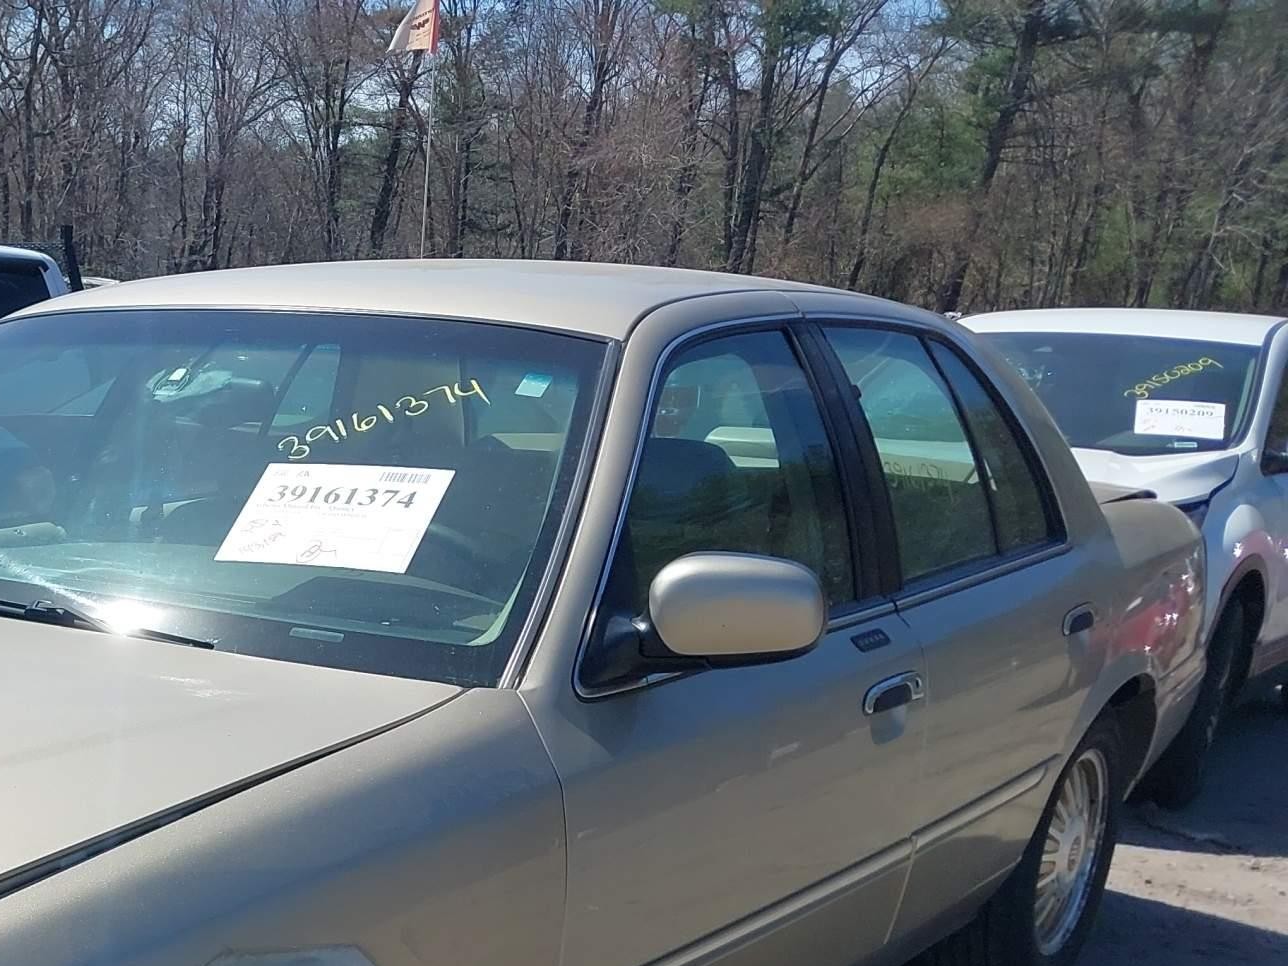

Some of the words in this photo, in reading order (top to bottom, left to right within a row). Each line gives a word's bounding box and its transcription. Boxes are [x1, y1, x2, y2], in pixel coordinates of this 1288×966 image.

[1124, 357, 1223, 399] 39150209
[278, 380, 490, 459] 39161374
[268, 485, 415, 508] 39161374
